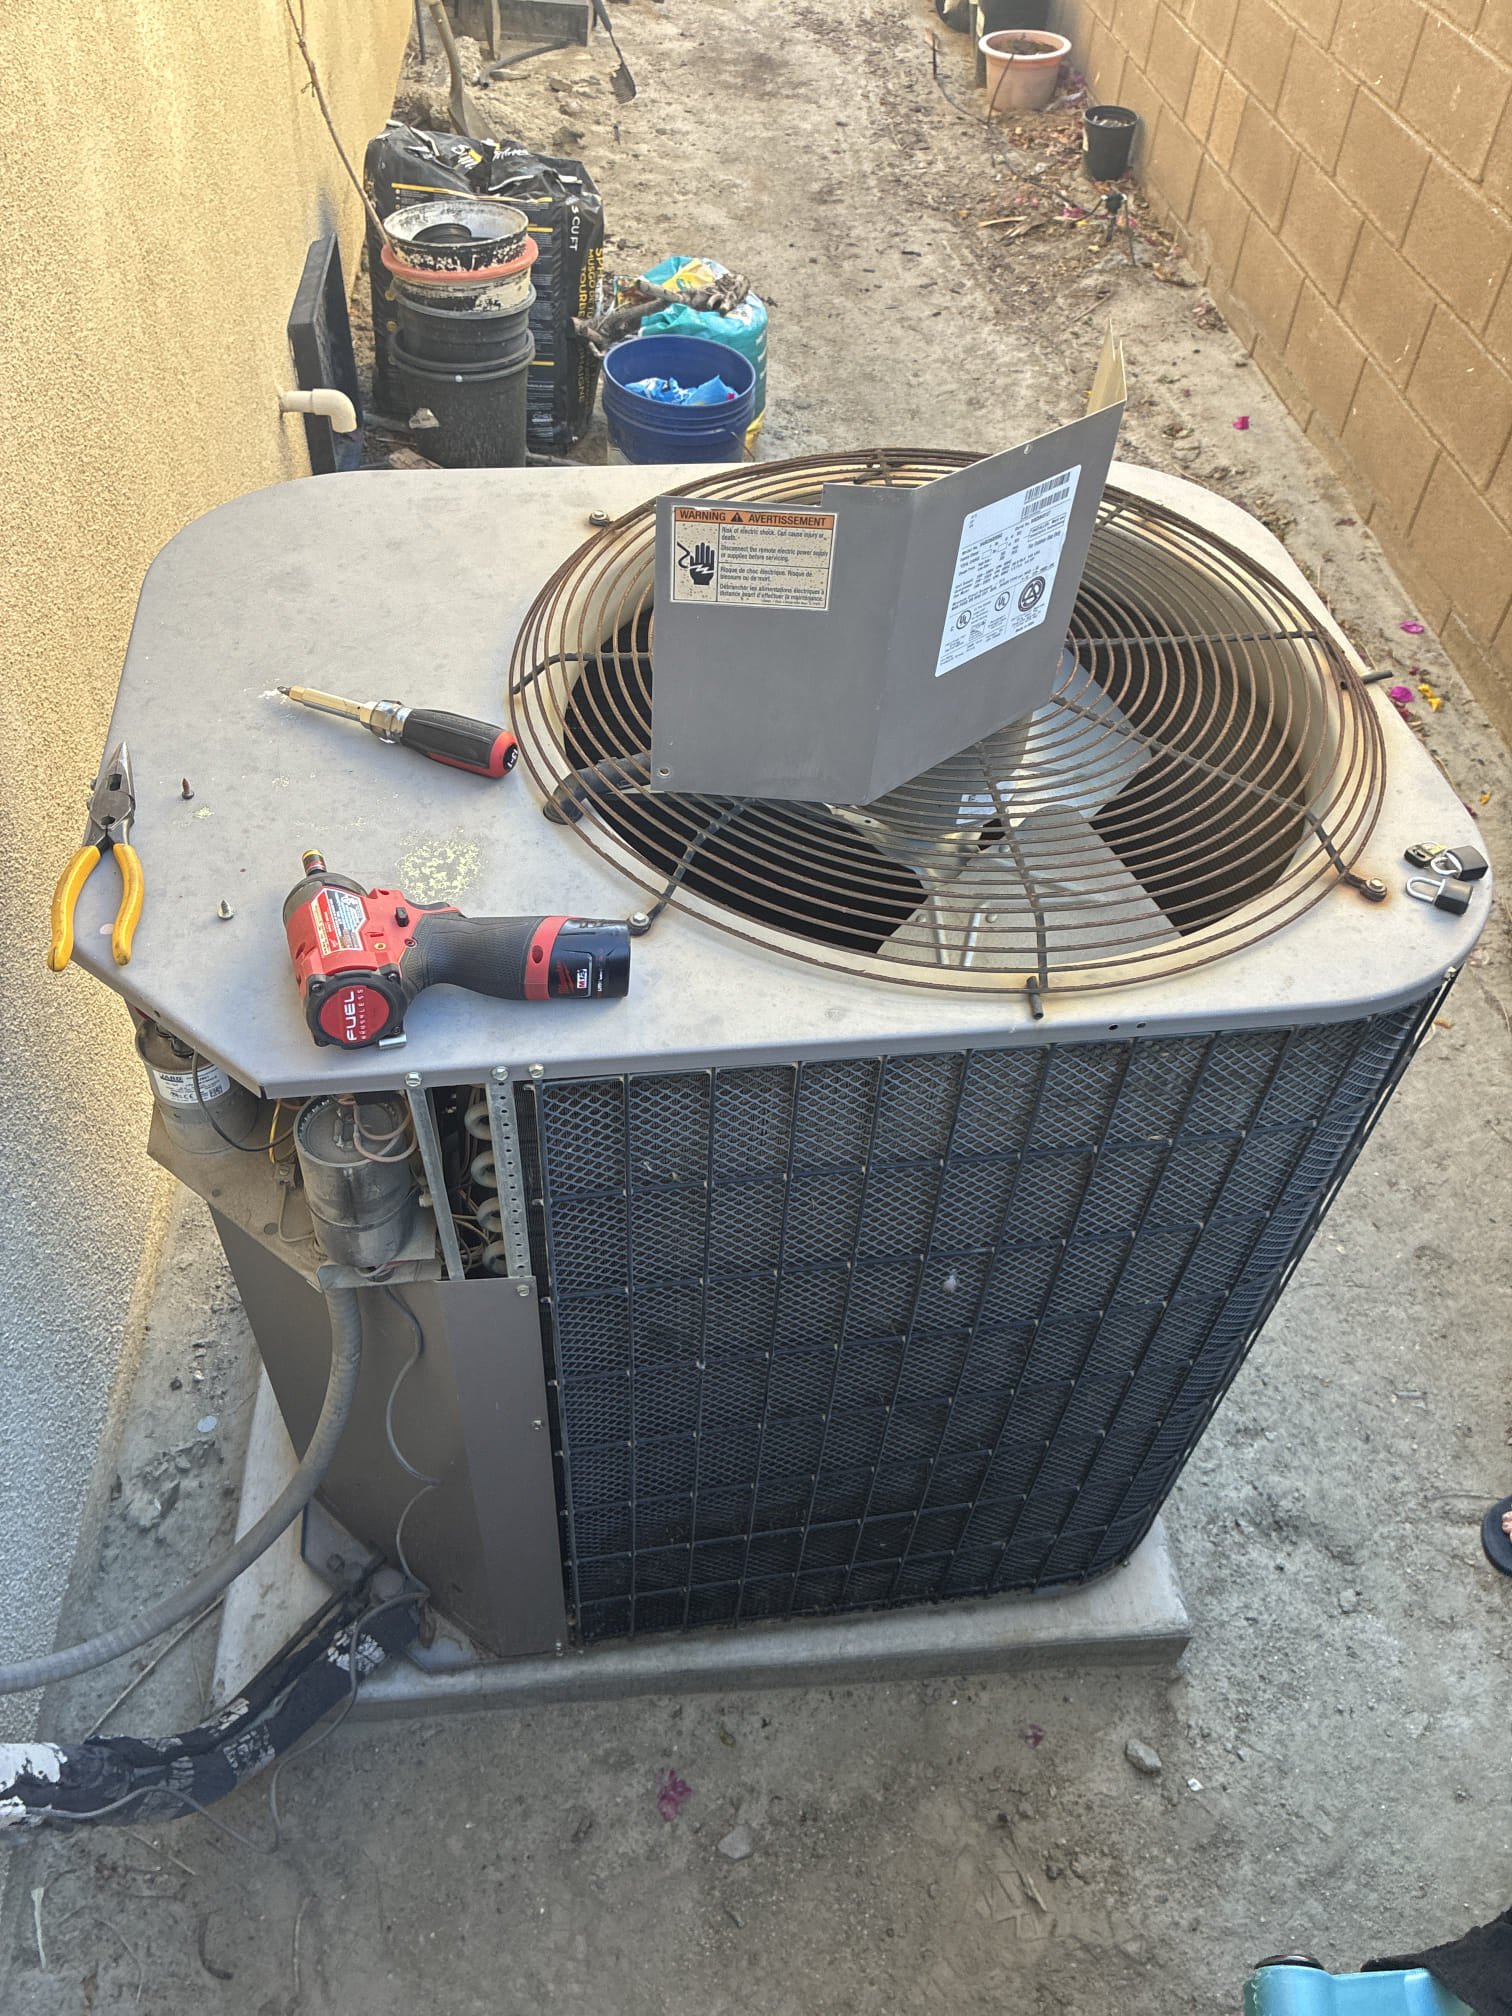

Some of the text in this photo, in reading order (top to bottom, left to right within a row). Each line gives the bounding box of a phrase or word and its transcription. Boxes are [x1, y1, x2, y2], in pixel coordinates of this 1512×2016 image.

[570, 216, 580, 235] CU
[569, 236, 579, 251] FT
[587, 248, 596, 288] MUSGO
[680, 510, 826, 526] WARNING AVERTISSEMENT
[760, 528, 775, 536] shock.
[344, 991, 357, 1041] FUEL
